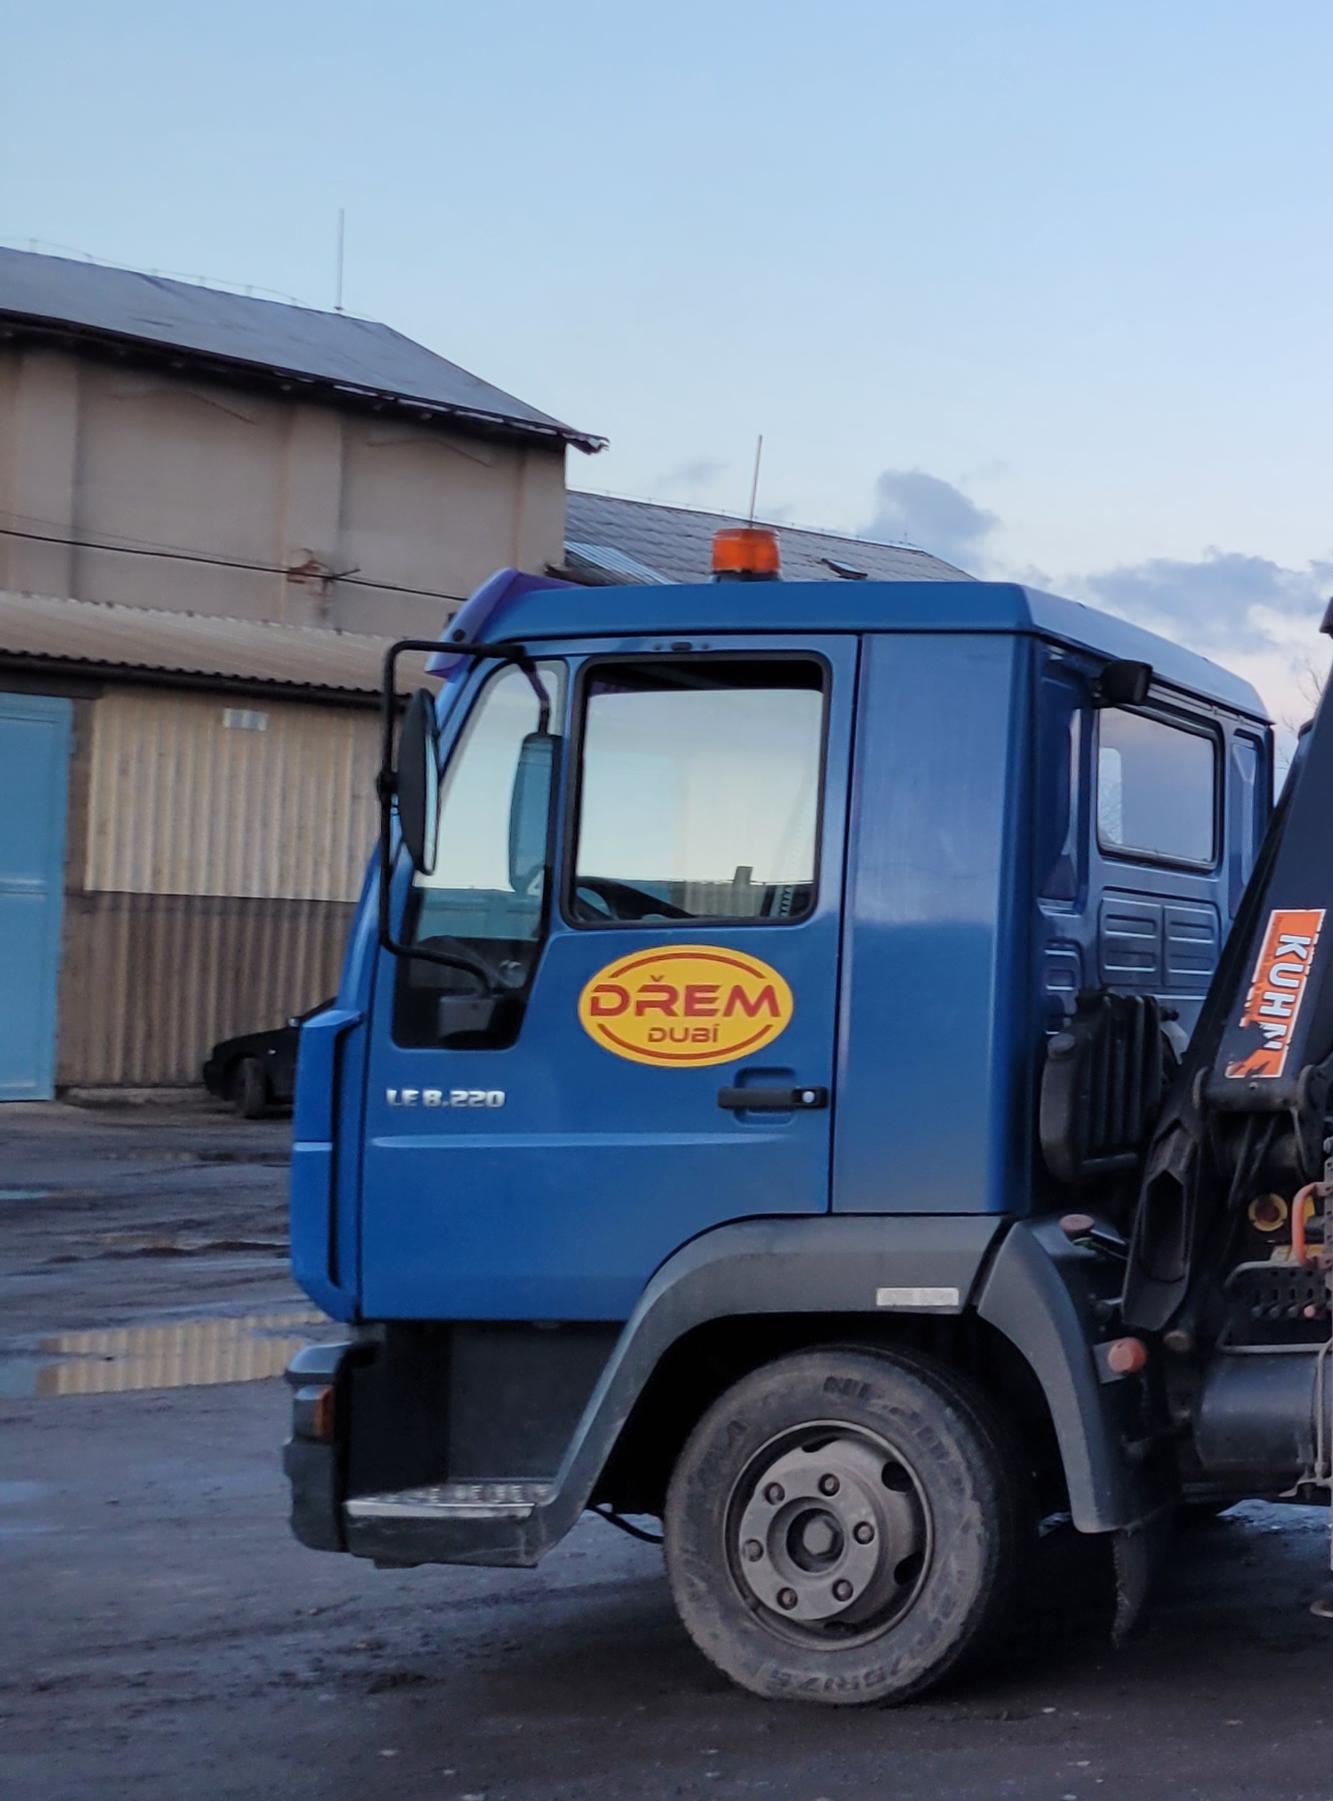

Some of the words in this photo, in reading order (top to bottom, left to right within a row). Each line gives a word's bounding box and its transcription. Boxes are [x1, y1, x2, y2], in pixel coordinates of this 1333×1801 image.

[589, 974, 782, 1018] DŘEM
[1258, 934, 1312, 1050] KUHN
[647, 1023, 719, 1043] DUBÍ
[386, 1089, 417, 1108] LE
[423, 1089, 506, 1108] 8.220
